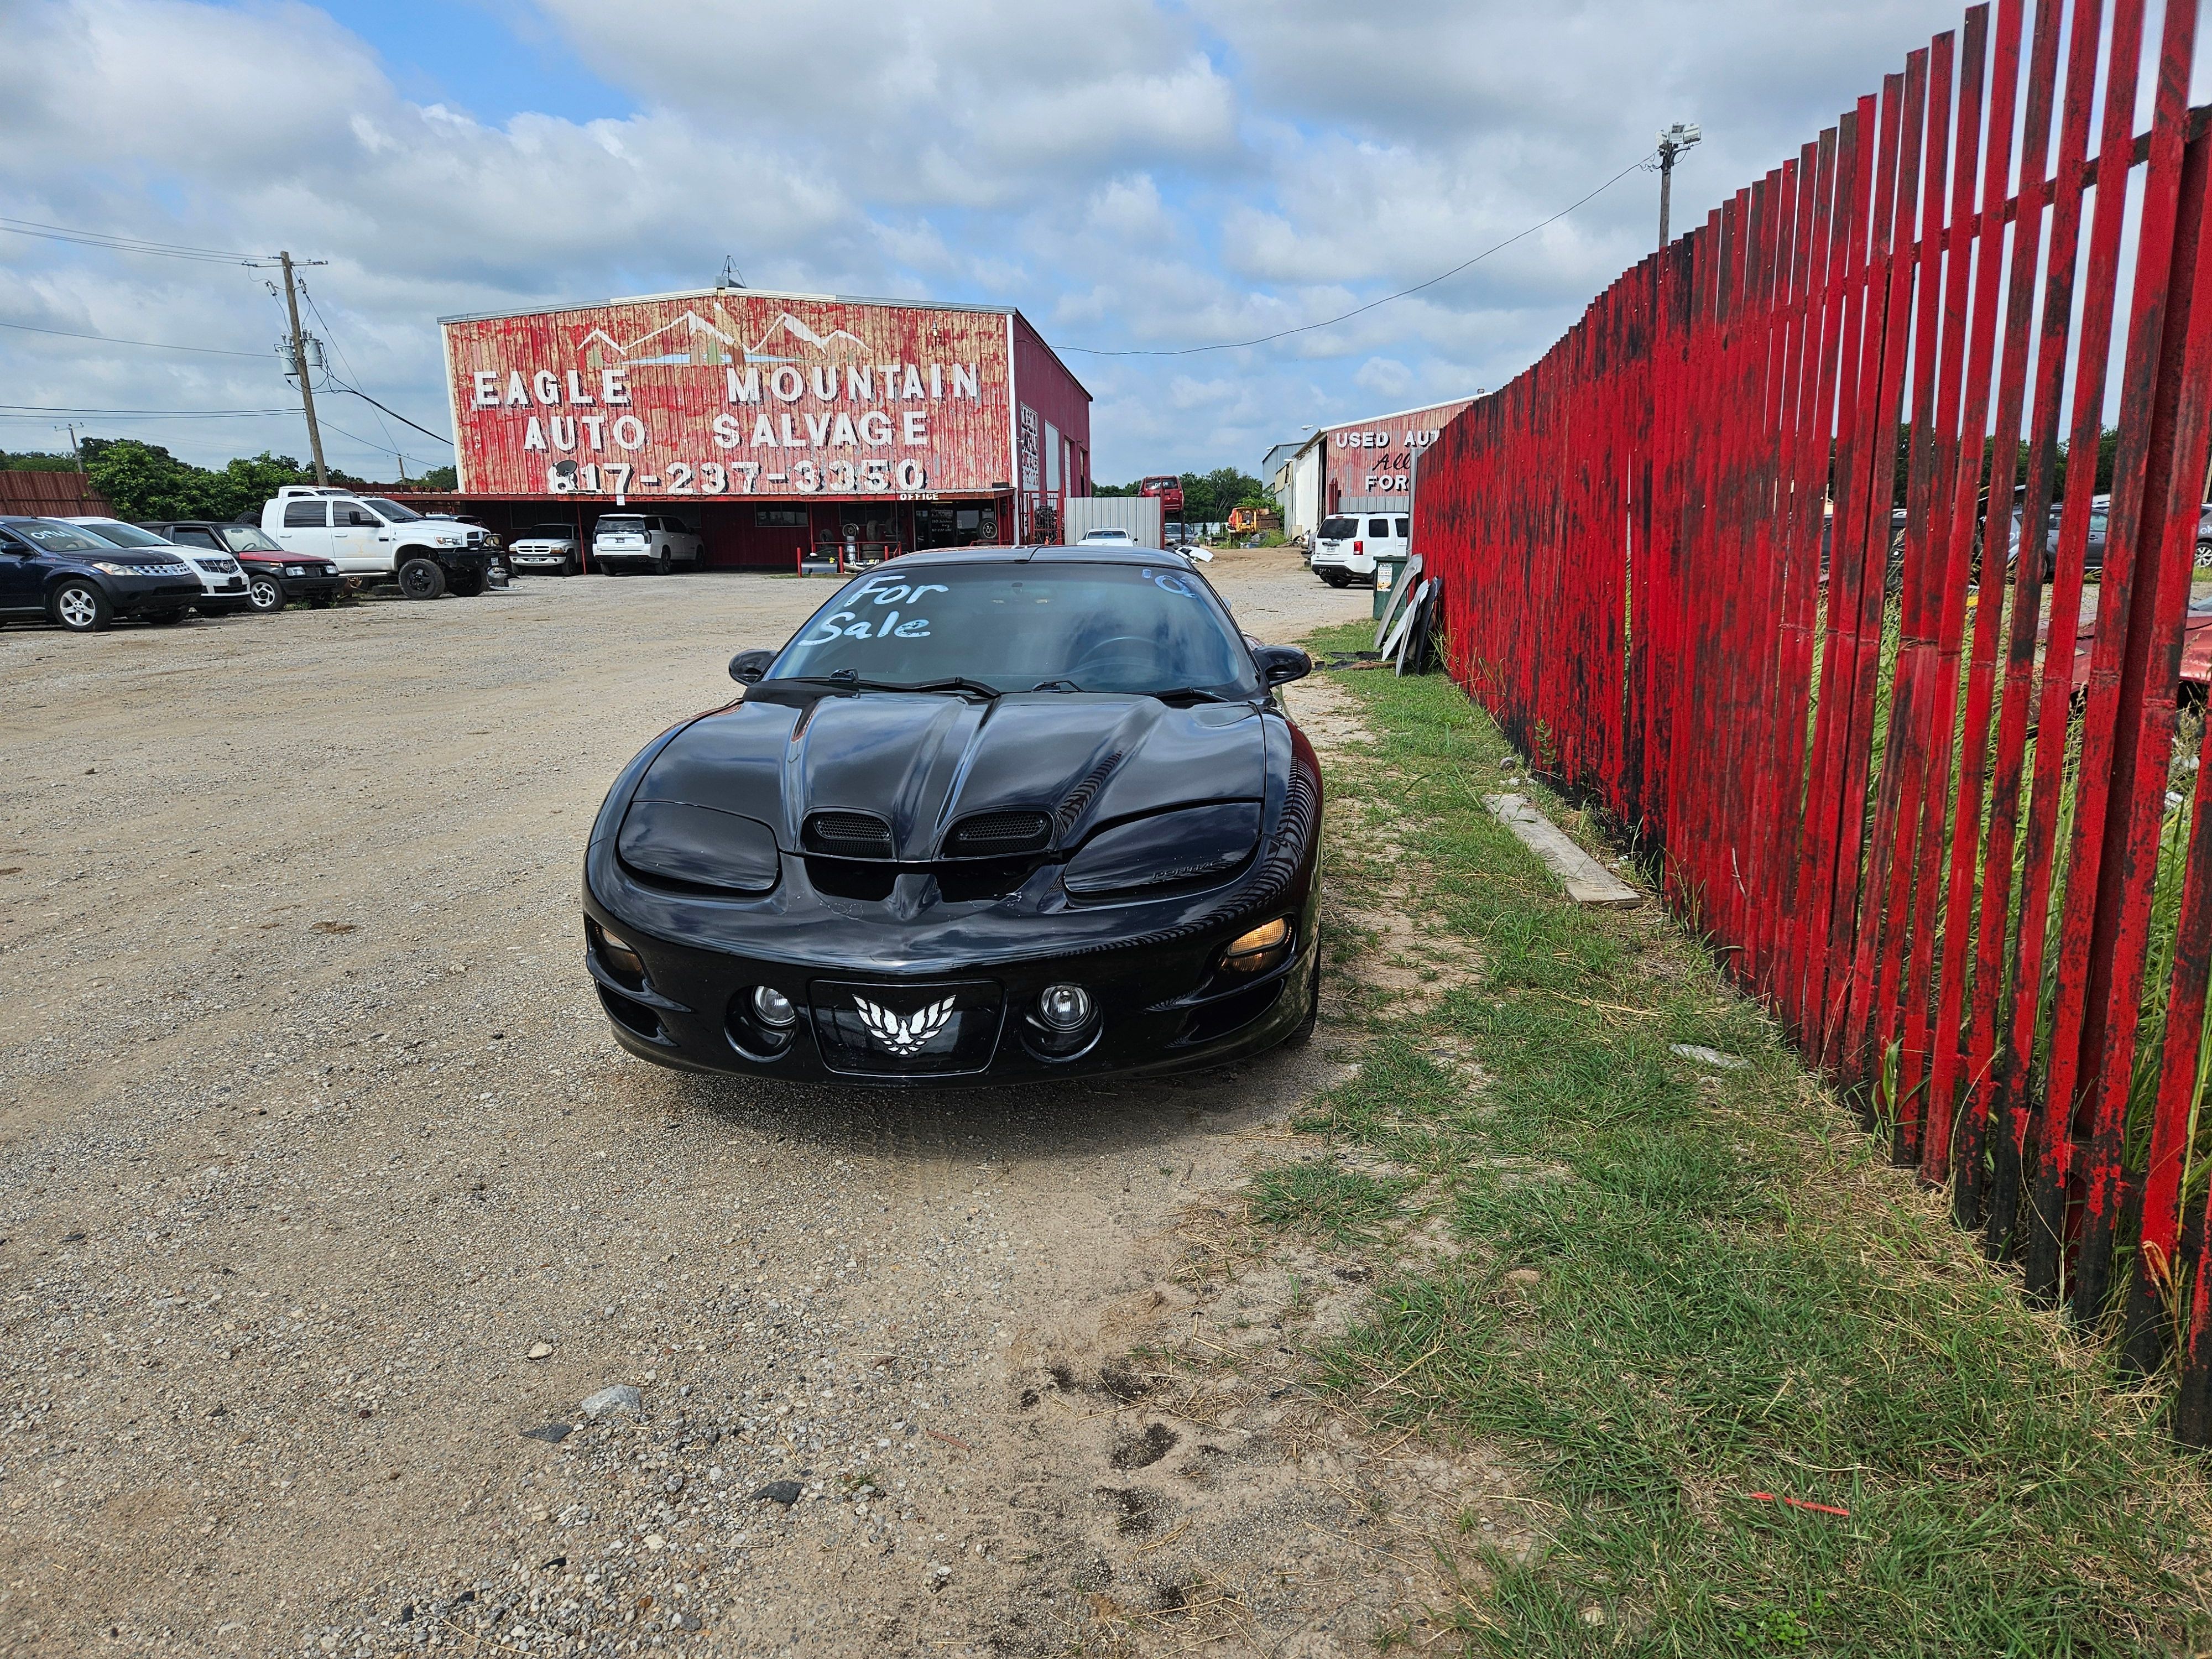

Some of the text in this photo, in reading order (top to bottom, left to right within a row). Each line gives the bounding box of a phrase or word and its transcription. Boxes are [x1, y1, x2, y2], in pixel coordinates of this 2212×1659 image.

[473, 363, 977, 406] EAGLE MOUNTAIN
[524, 411, 927, 450] AUTO SALVAGE
[1336, 431, 1389, 448] USED
[547, 458, 924, 494] 817-237-3350
[1365, 474, 1407, 491] FOR
[843, 575, 949, 607] For
[797, 611, 931, 646] Sale
[1152, 859, 1222, 879] PONTIAC
